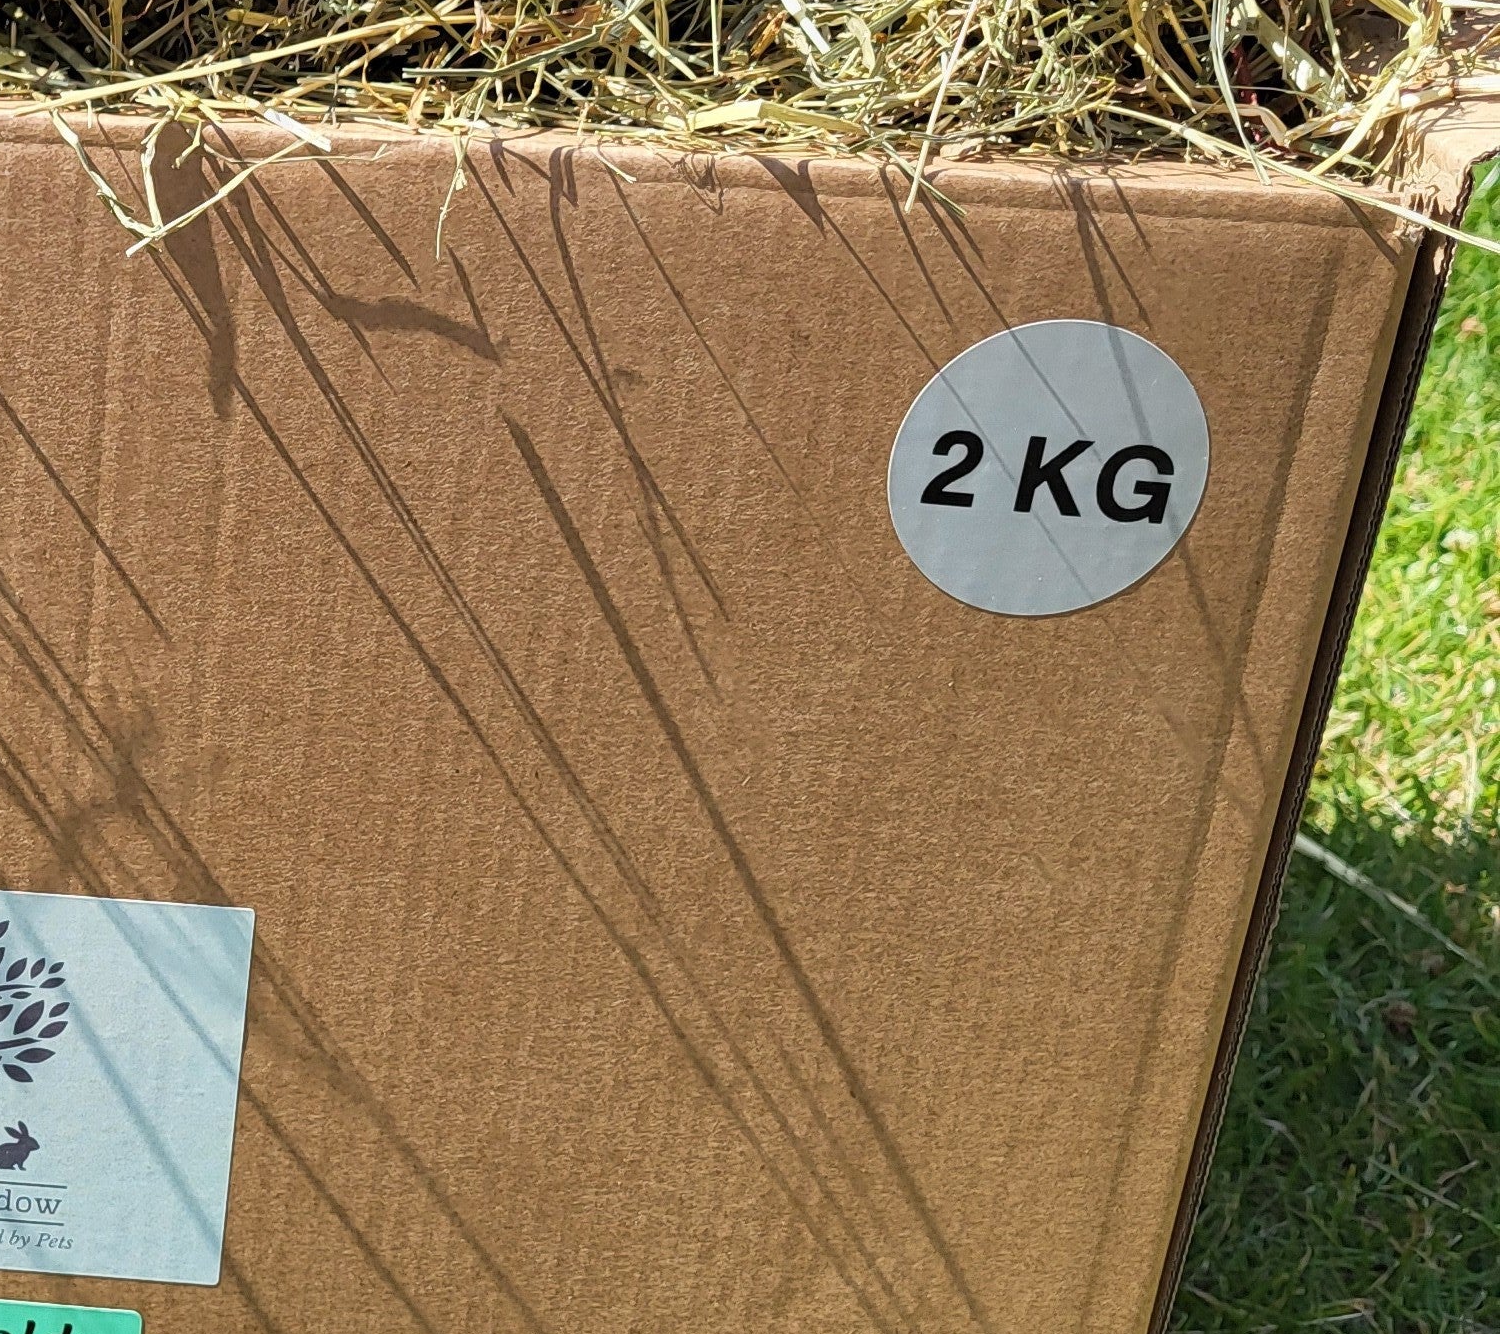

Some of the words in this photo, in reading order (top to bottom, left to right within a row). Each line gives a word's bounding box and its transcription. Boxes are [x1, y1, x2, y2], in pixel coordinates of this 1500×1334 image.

[920, 430, 984, 508] 2
[1013, 436, 1175, 524] KG
[8, 1229, 31, 1250] by
[35, 1233, 74, 1250] Pets
